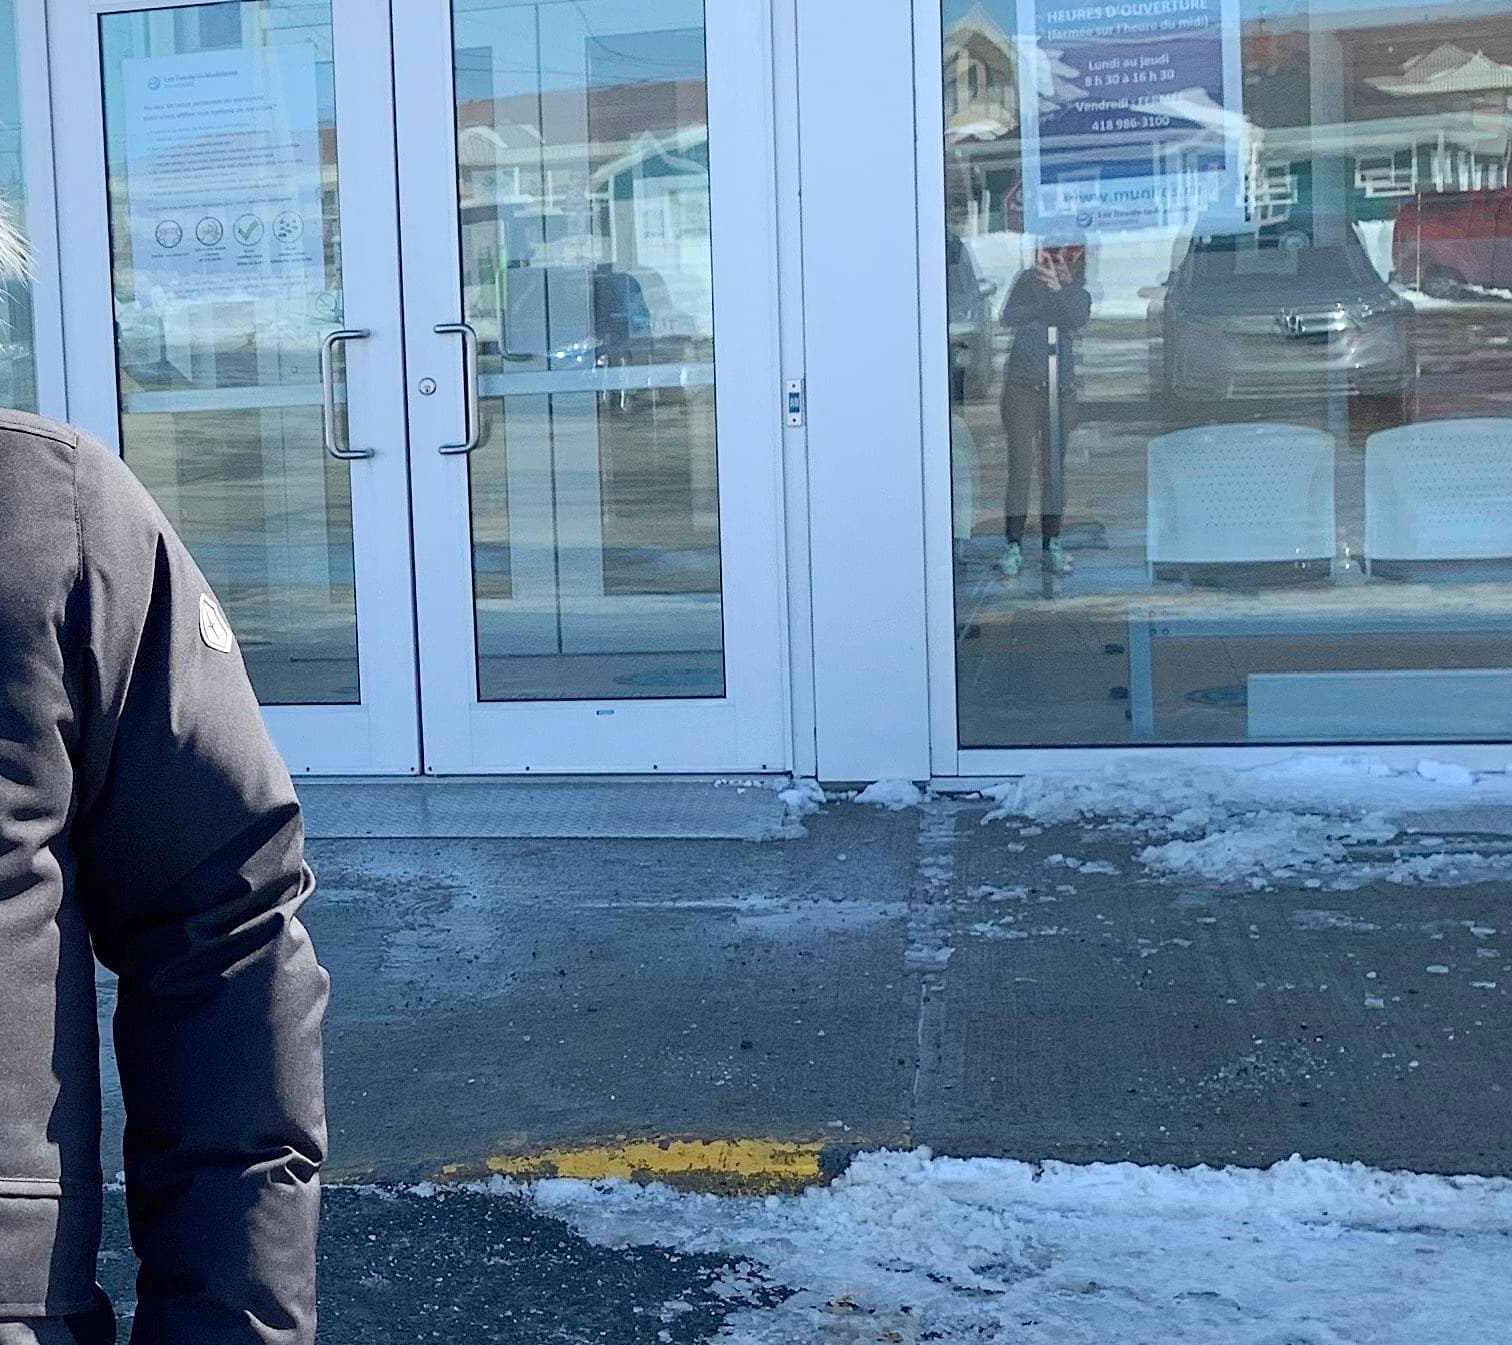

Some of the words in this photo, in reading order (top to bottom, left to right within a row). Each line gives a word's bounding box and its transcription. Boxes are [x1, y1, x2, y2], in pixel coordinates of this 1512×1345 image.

[1047, 6, 1102, 23] HEURES
[1160, 17, 1175, 30] du
[1088, 57, 1120, 71] Lundi
[1123, 57, 1137, 67] au
[1140, 53, 1169, 69] jeudi
[1094, 75, 1103, 86] h
[1105, 74, 1120, 85] 30
[1133, 71, 1147, 83] 16
[1149, 70, 1157, 82] h
[1159, 69, 1175, 81] 30
[1075, 97, 1128, 112] Vendredi
[1091, 119, 1114, 131] 418
[1116, 115, 1170, 130] 986-3100
